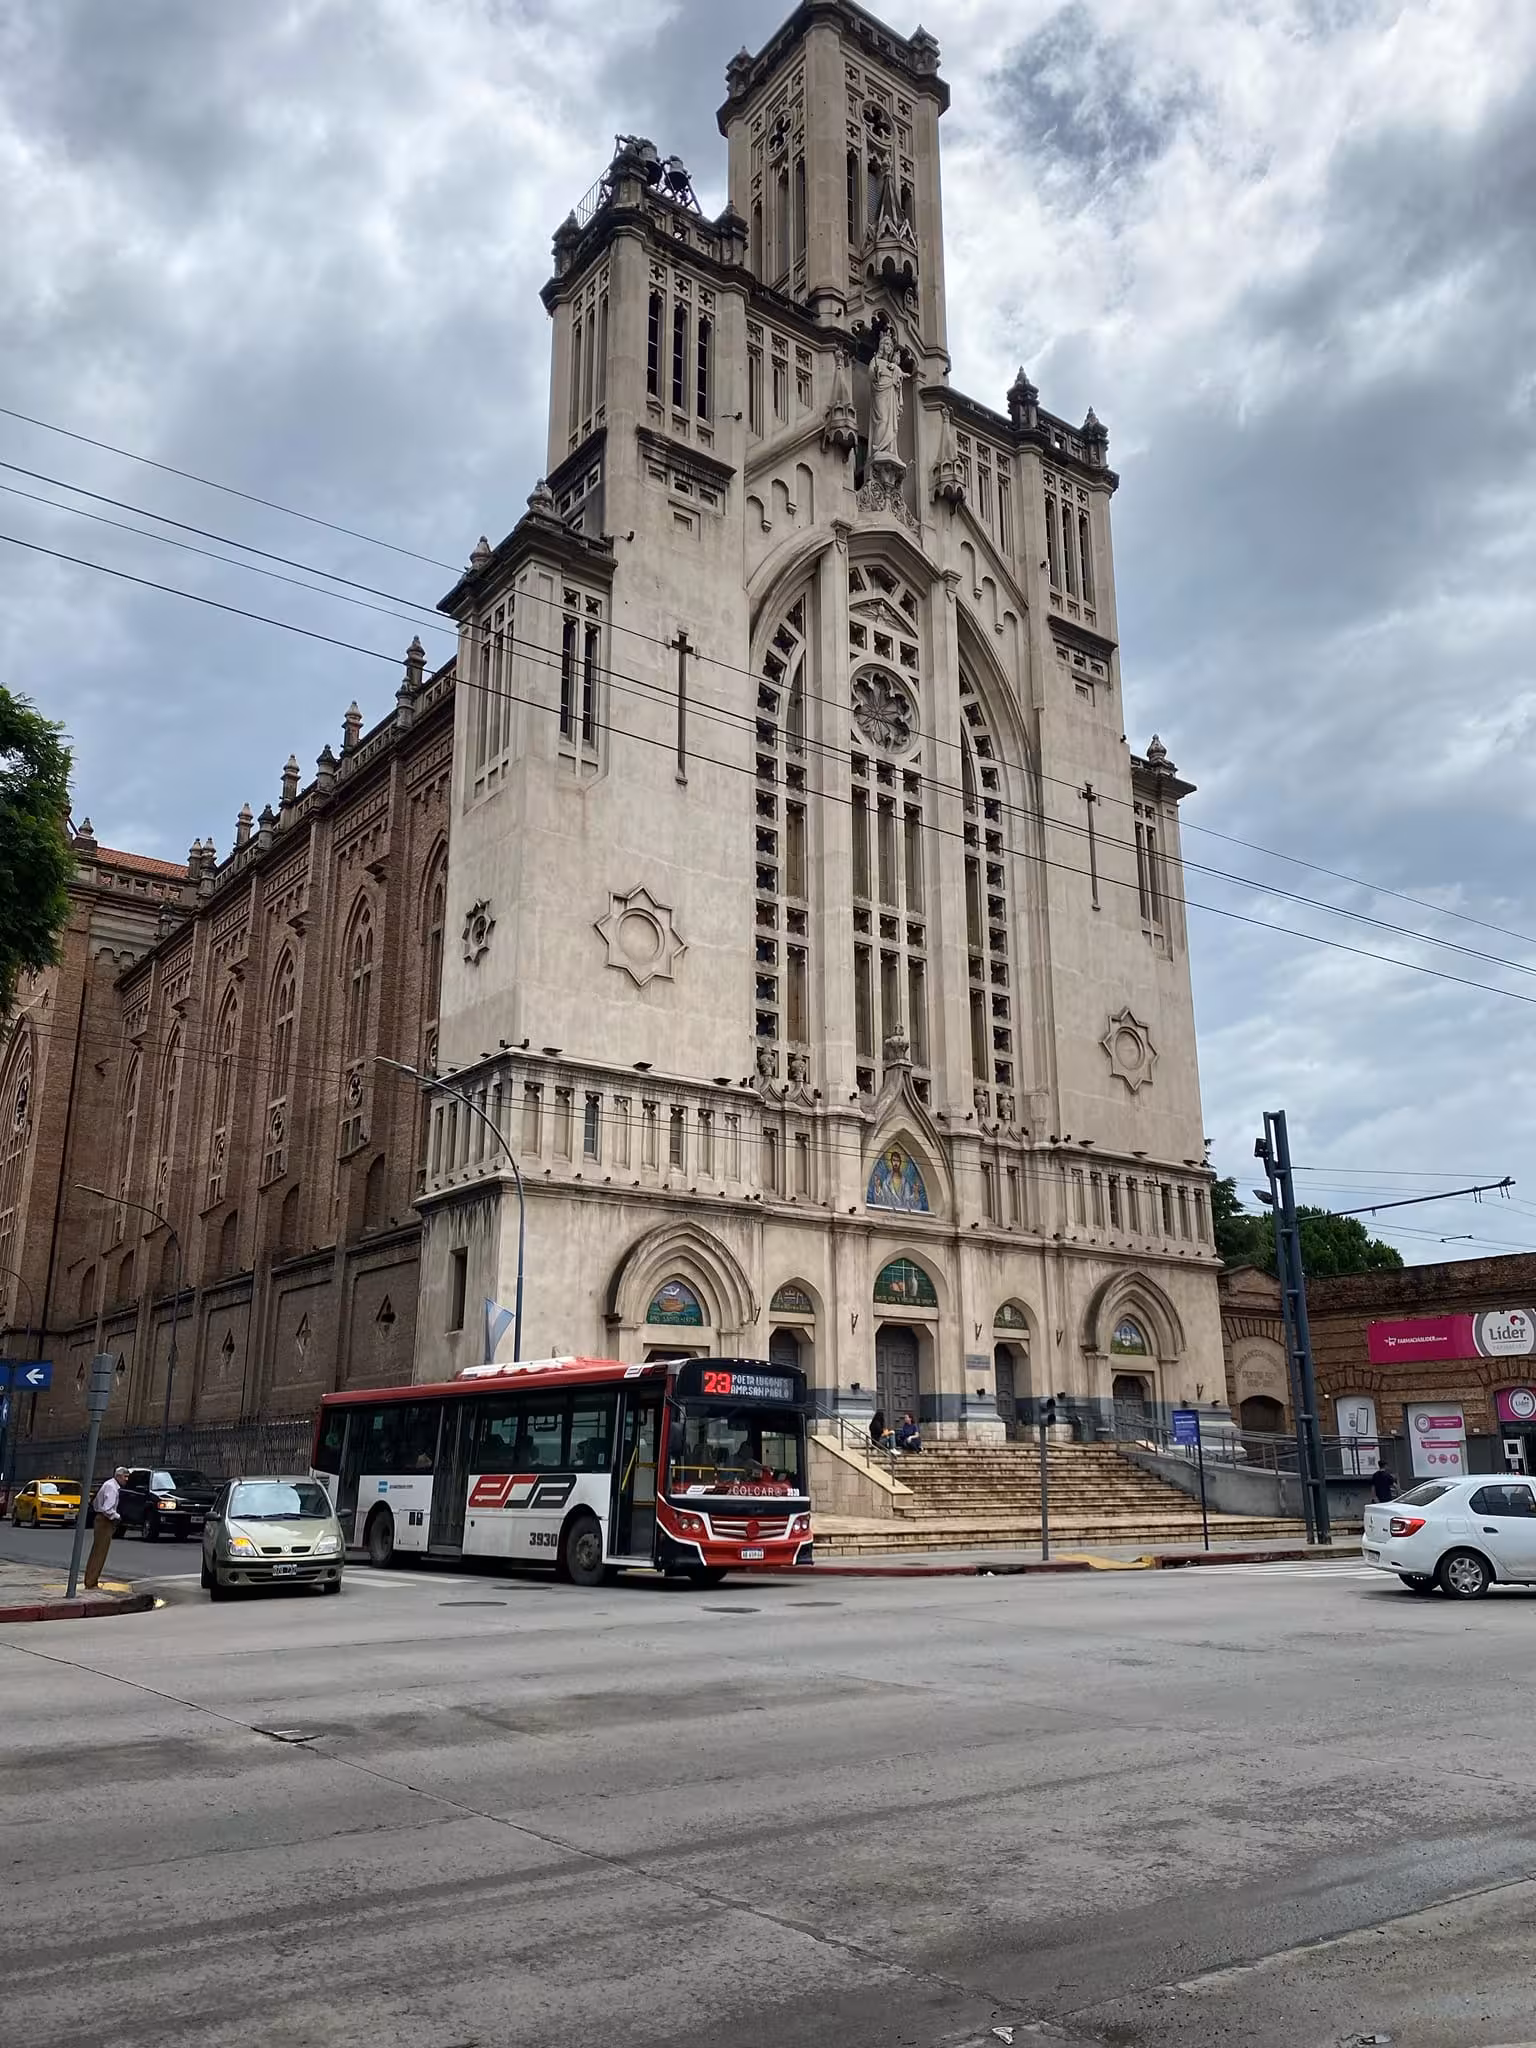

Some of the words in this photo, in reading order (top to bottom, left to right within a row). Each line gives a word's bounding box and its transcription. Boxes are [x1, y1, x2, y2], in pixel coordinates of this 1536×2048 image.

[1489, 1326, 1526, 1340] Líder
[704, 1372, 731, 1393] 23
[731, 1374, 755, 1385] POETA
[529, 1533, 558, 1547] 3930
